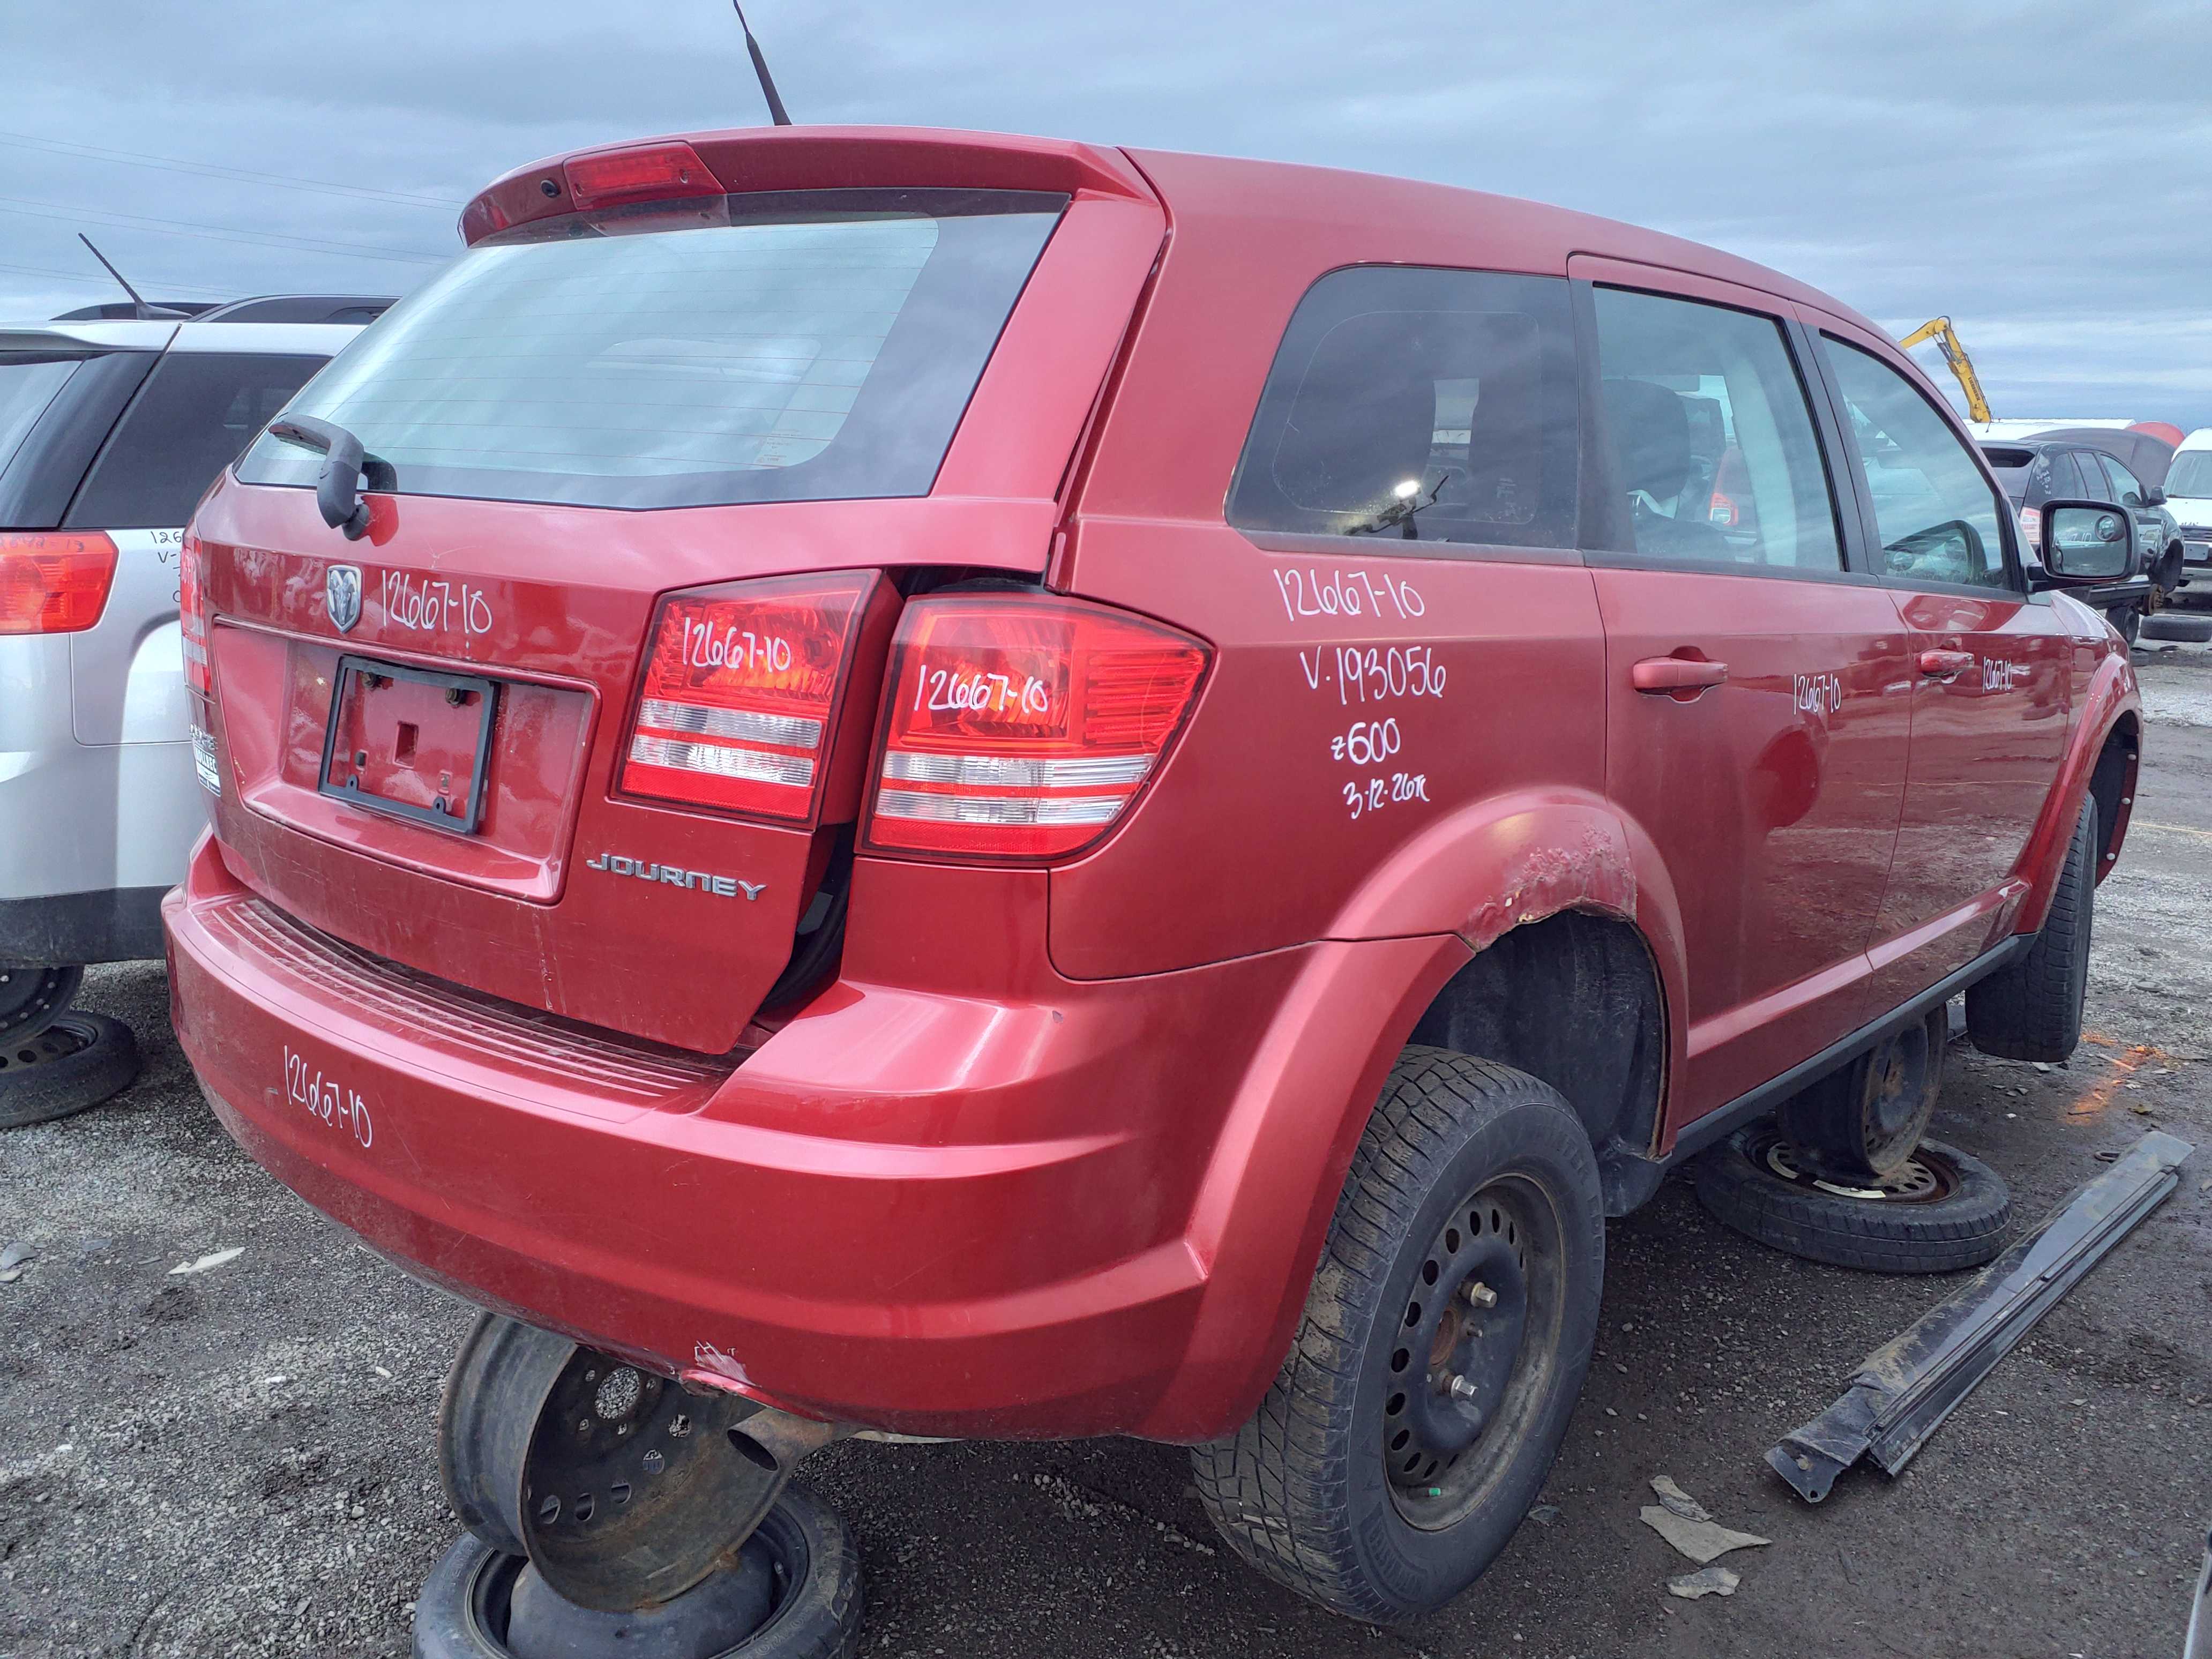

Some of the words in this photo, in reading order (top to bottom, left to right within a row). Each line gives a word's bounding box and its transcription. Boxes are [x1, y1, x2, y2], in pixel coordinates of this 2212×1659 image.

[381, 569, 492, 634] 12667-10
[1273, 569, 1425, 622] 12667-10
[683, 617, 791, 673] 12667-10
[913, 664, 1048, 714] 12667-10
[1792, 672, 1842, 715] 12667-10
[1982, 655, 2013, 694] 12667-10
[586, 853, 767, 901] JOURNEY
[283, 1044, 373, 1148] 12667-10
